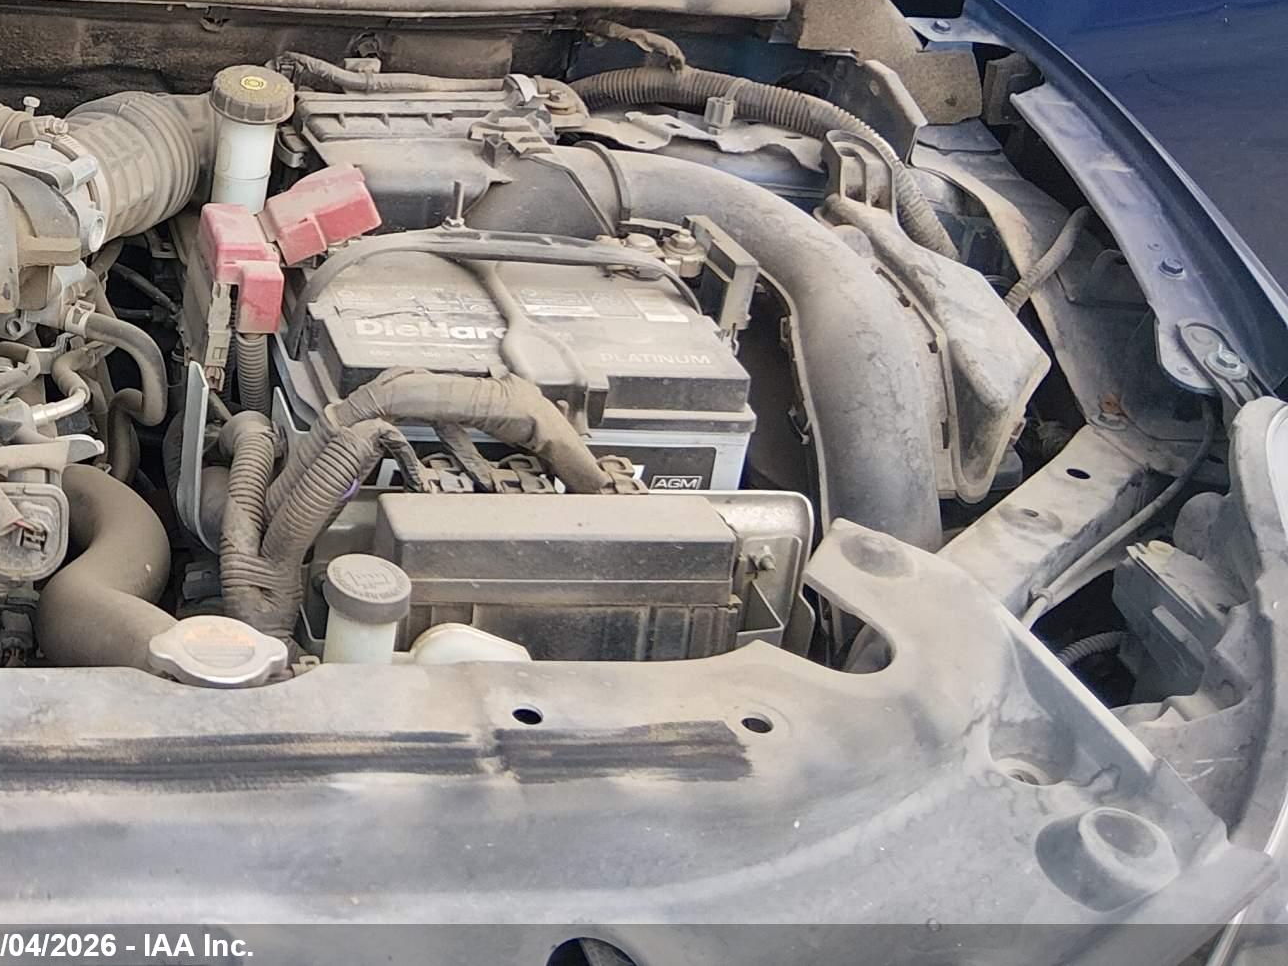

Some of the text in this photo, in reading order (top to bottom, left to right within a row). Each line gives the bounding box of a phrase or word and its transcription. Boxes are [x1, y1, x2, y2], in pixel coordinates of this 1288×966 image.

[354, 319, 509, 340] DieHar
[599, 351, 712, 365] PLATINUM
[653, 477, 699, 490] AGM
